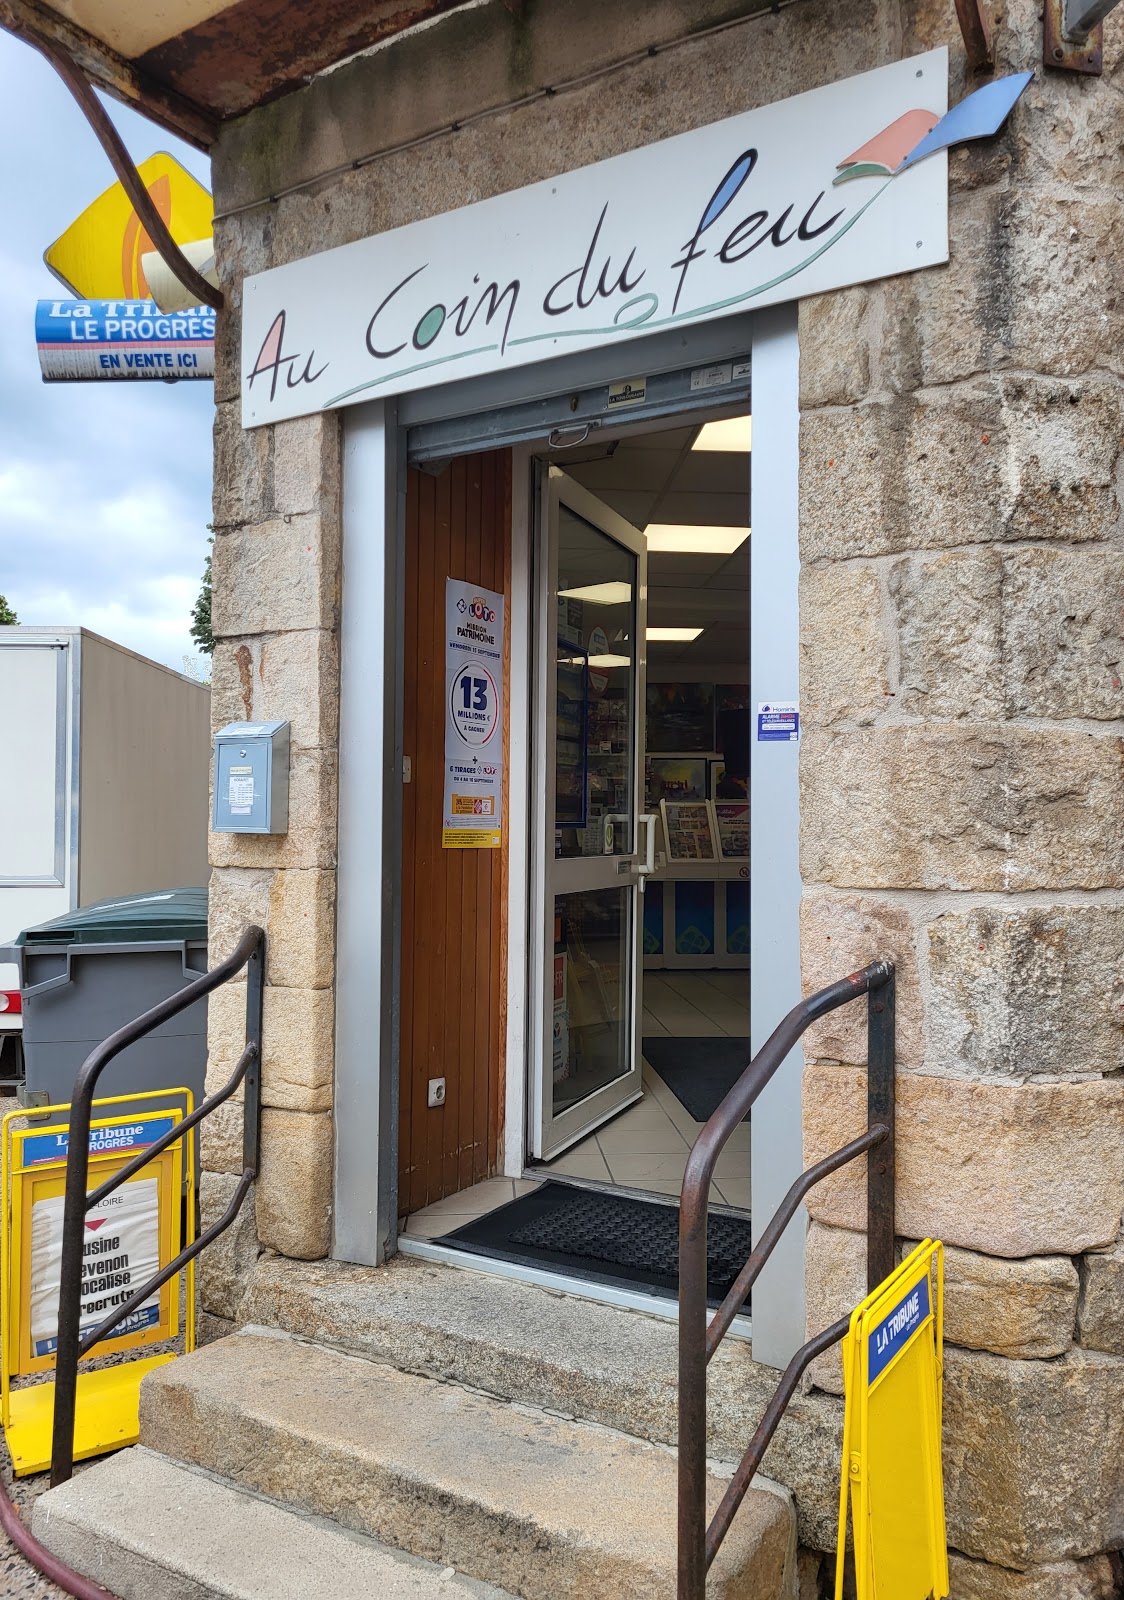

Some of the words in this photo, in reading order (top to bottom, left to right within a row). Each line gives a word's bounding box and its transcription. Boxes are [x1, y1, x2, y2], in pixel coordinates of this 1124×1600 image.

[247, 309, 330, 402] Au
[365, 262, 520, 356] Coin
[543, 200, 647, 316] du
[671, 148, 846, 316] feu
[49, 302, 92, 318] La
[102, 302, 215, 318] Triun
[71, 320, 98, 341] LE
[100, 354, 121, 369] EN
[124, 353, 173, 368] VENTE
[178, 353, 198, 368] ICI
[469, 603, 496, 622] LOTO
[457, 627, 495, 645] PATRIMOINE
[466, 622, 487, 634] MISSION
[460, 675, 488, 711] 13
[457, 710, 486, 721] MILLIONS
[454, 766, 476, 774] TIRAGES
[91, 1125, 144, 1141] ribune
[89, 1136, 134, 1152] ROGRES
[81, 1254, 129, 1278] evenon
[81, 1271, 131, 1296] ocalise
[876, 1328, 889, 1355] LA
[887, 1291, 920, 1341] TRIBUNE
